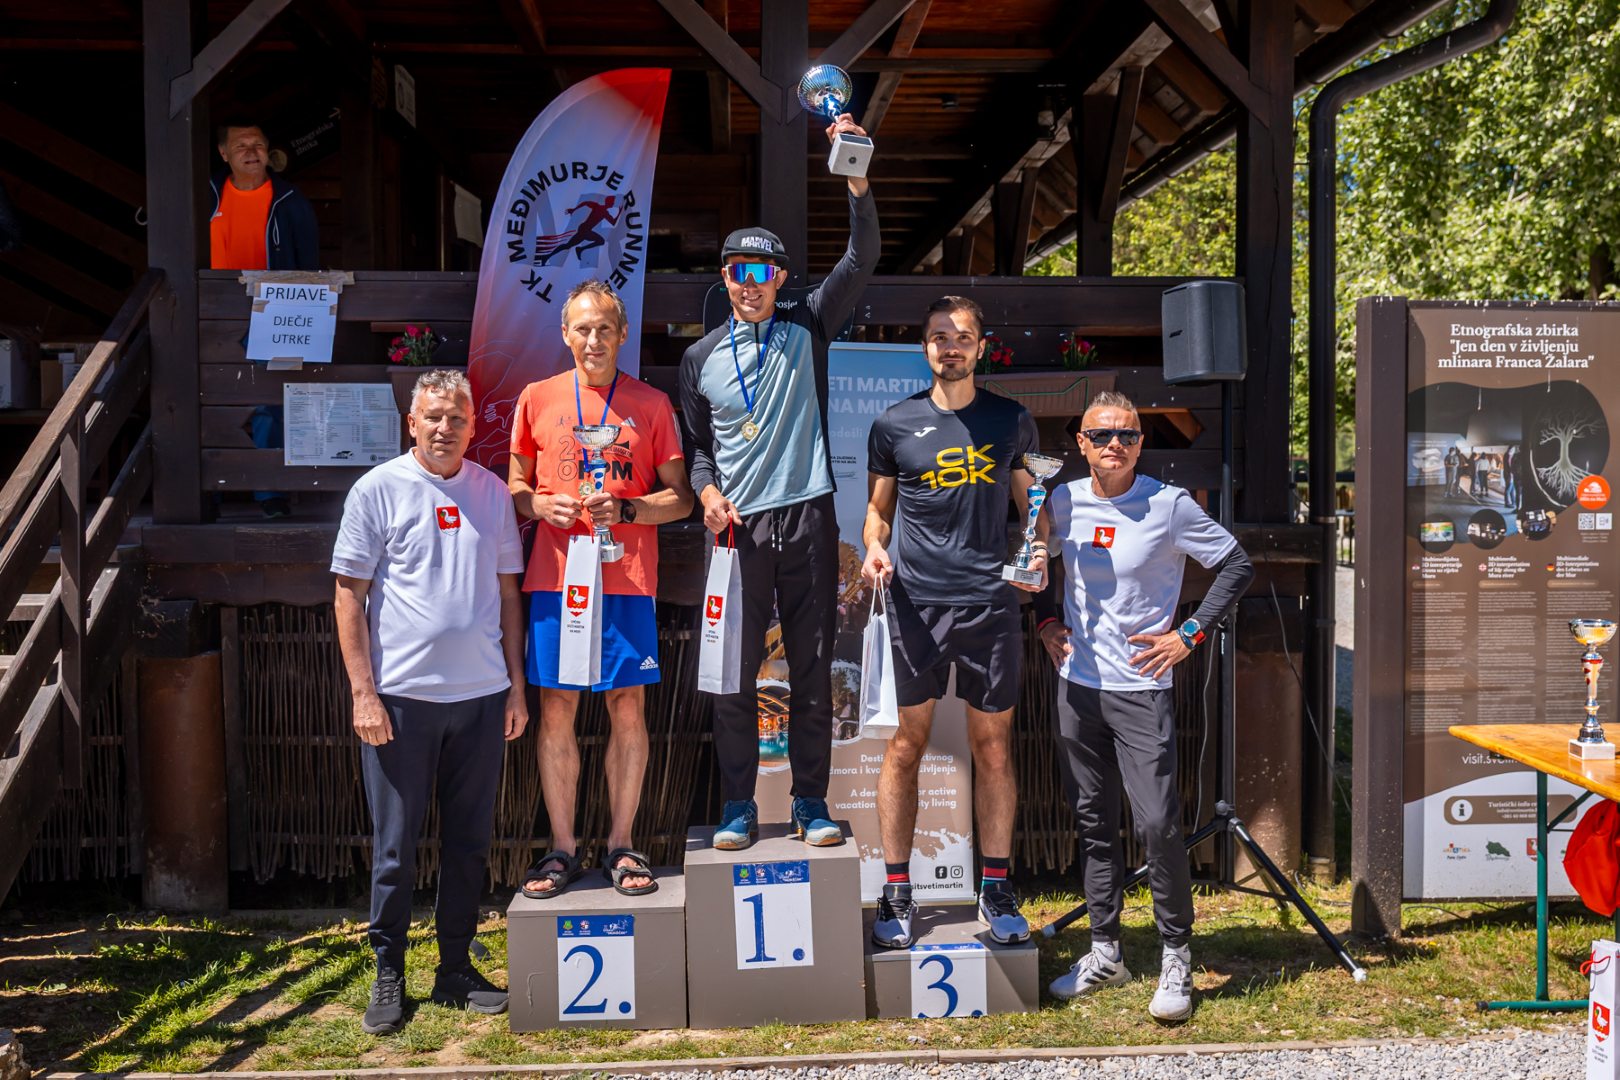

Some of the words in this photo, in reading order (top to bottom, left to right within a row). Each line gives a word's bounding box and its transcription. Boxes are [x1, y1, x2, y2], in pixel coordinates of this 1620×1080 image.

[507, 161, 624, 263] MEĐIMURJE
[605, 189, 644, 291] RUNNE
[741, 236, 773, 252] MARVEL
[265, 286, 328, 301] PRIJAVE
[521, 269, 553, 303] TK
[273, 314, 313, 328] DJEČJE
[1450, 324, 1532, 339] Etnografska
[1535, 323, 1579, 337] zbirka
[272, 334, 311, 345] UTRKE
[1480, 340, 1506, 353] den
[1508, 343, 1517, 352] v
[1520, 340, 1579, 355] življenju
[1438, 355, 1492, 368] mlinara
[1495, 356, 1542, 368] Franca
[828, 376, 852, 391] ETI
[829, 398, 854, 413] NA
[858, 399, 899, 414] MU
[830, 426, 863, 438] odošli
[936, 444, 996, 468] CK
[920, 464, 996, 489] 10K
[829, 765, 858, 774] dmora
[850, 789, 858, 797] A
[928, 787, 957, 796] active
[835, 800, 876, 809] vacation
[931, 797, 957, 809] living
[743, 892, 806, 963] 1.
[563, 944, 632, 1014] 2.
[918, 954, 983, 1018] 3.
